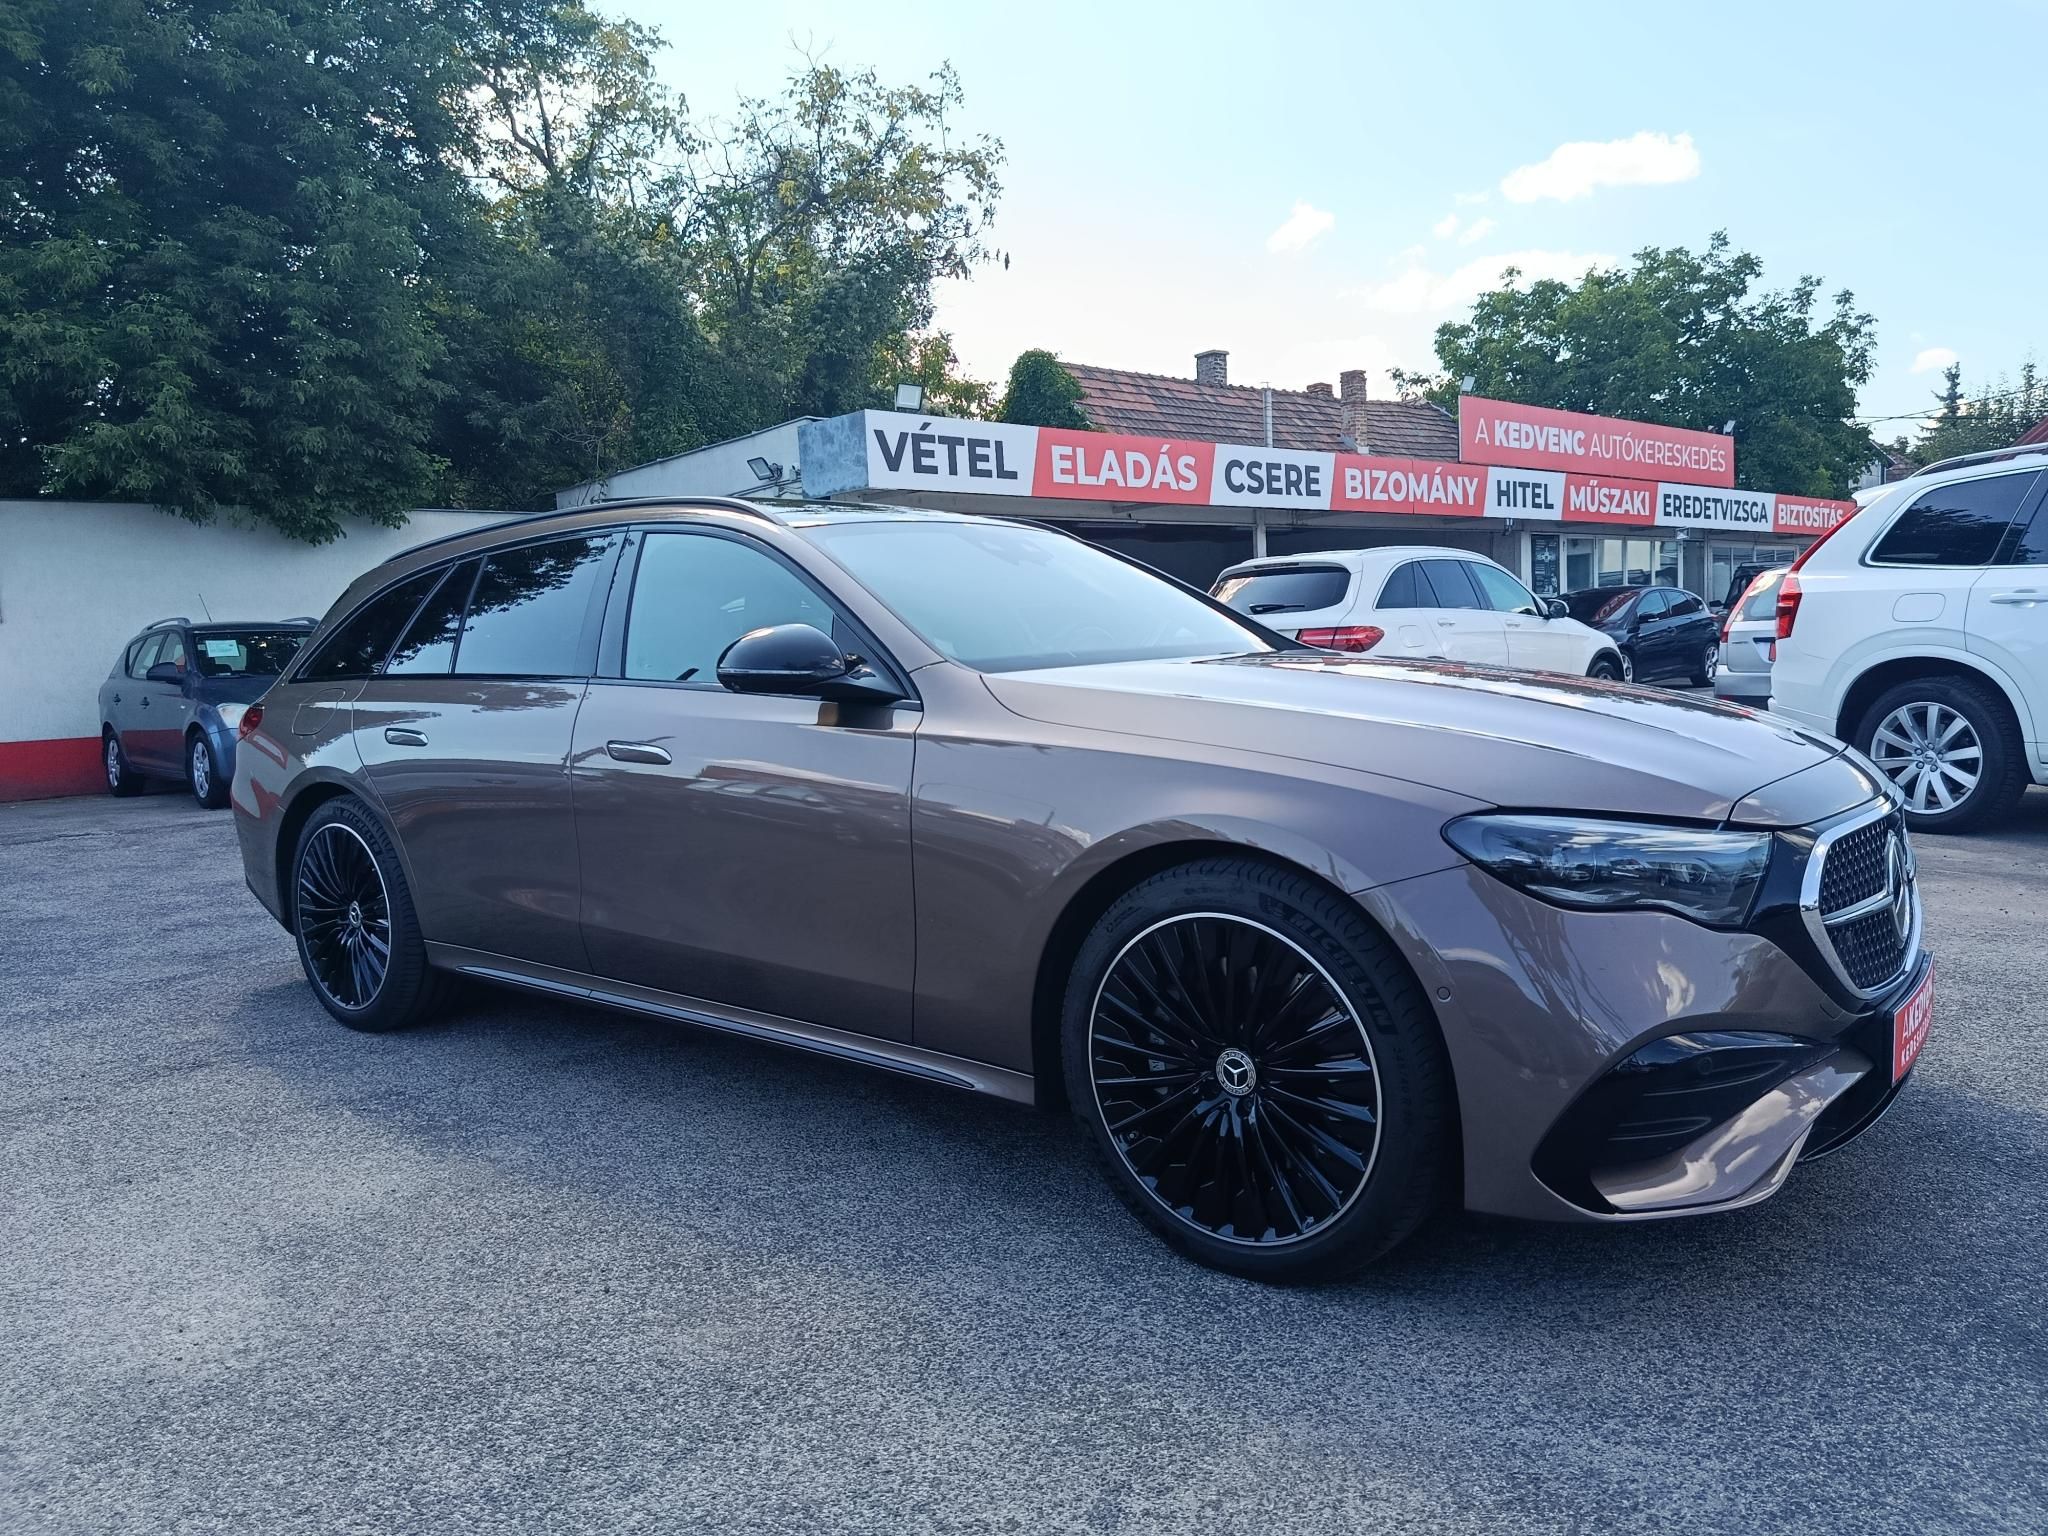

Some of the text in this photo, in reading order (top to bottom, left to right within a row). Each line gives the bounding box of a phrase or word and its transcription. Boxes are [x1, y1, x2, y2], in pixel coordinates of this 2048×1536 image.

[873, 421, 1844, 529] VÉTEL ELADÁS CSERE BIZOMÁNY HITEL MŰSZAKI EREDETVIZSGA BIZTOSÍTÁS
[1474, 417, 1727, 473] A KEDVENC AUTÓKERESKEDÉS
[1288, 910, 1397, 1033] MICHELIN
